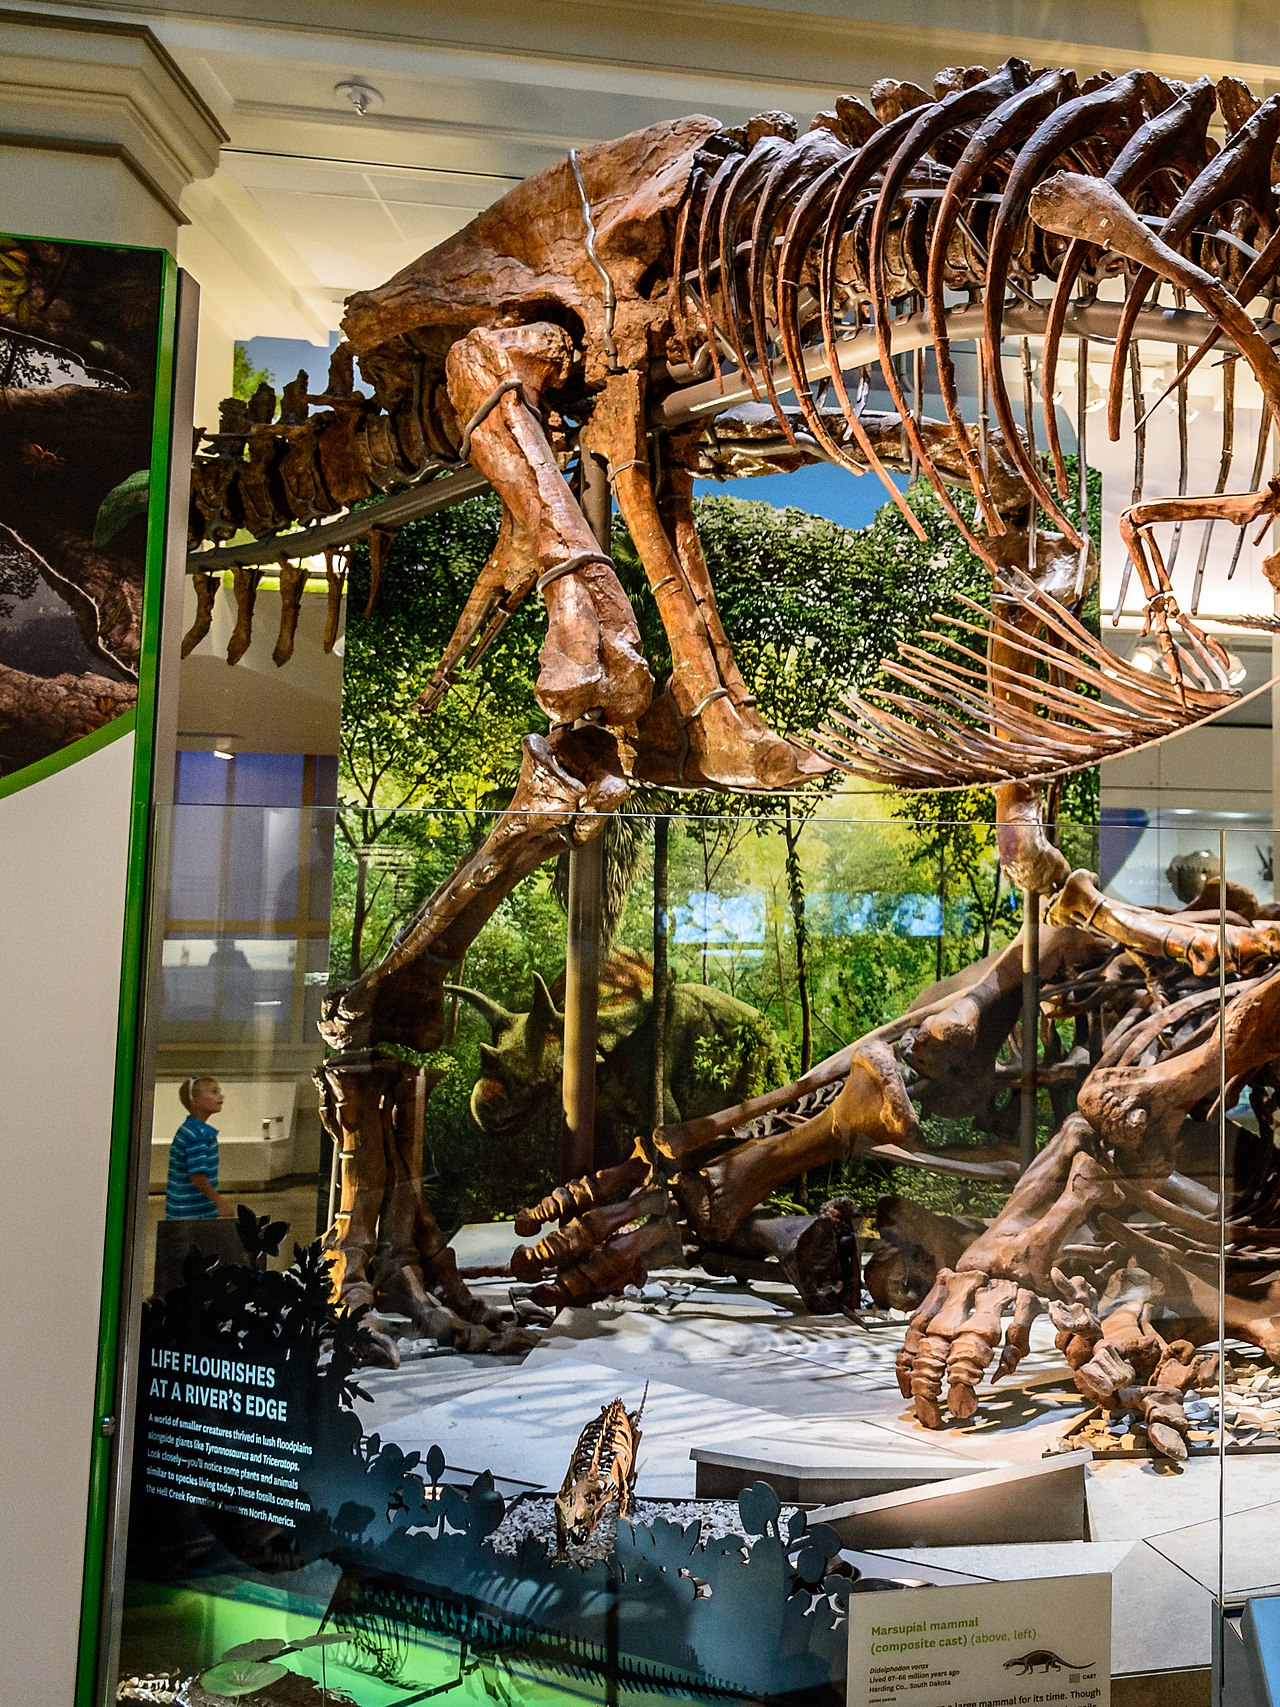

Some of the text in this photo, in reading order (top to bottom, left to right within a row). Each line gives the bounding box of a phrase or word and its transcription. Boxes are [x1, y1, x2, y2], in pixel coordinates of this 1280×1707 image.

[152, 1348, 275, 1388] LIFE FLOURISHES
[150, 1378, 287, 1422] AT A RIVER’S EDGE
[148, 1431, 300, 1472] alongside giants like Tyrannosaurus and Triceratops.
[149, 1413, 312, 1455] A world of smaller creatures thrived in lush floodplains
[147, 1466, 310, 1512] similar to species living today. These fossils come from
[148, 1449, 162, 1459] Look
[204, 1461, 222, 1473] notice
[224, 1466, 239, 1477] some
[241, 1468, 260, 1482] plants
[261, 1474, 273, 1484] and
[274, 1476, 298, 1490] animals
[146, 1484, 155, 1494] the
[157, 1487, 169, 1497] Hell
[169, 1489, 185, 1501] Creek
[186, 1493, 214, 1506] Formation
[224, 1503, 249, 1516] western
[249, 1508, 268, 1522] North
[268, 1512, 296, 1528] America.
[871, 1628, 1036, 1656] (composite cast) (above, left)
[872, 1616, 978, 1636] Marsupial mammal
[870, 1665, 910, 1674] Didelphodon
[870, 1675, 886, 1684] Lived
[908, 1672, 929, 1680] million
[930, 1671, 947, 1679] years
[870, 1685, 894, 1693] Harding
[910, 1681, 927, 1689] South
[979, 1696, 1016, 1707] mammal
[1019, 1695, 1031, 1704] for
[1034, 1694, 1044, 1703] its
[1046, 1692, 1067, 1701] time.
[1070, 1688, 1100, 1699] Though
